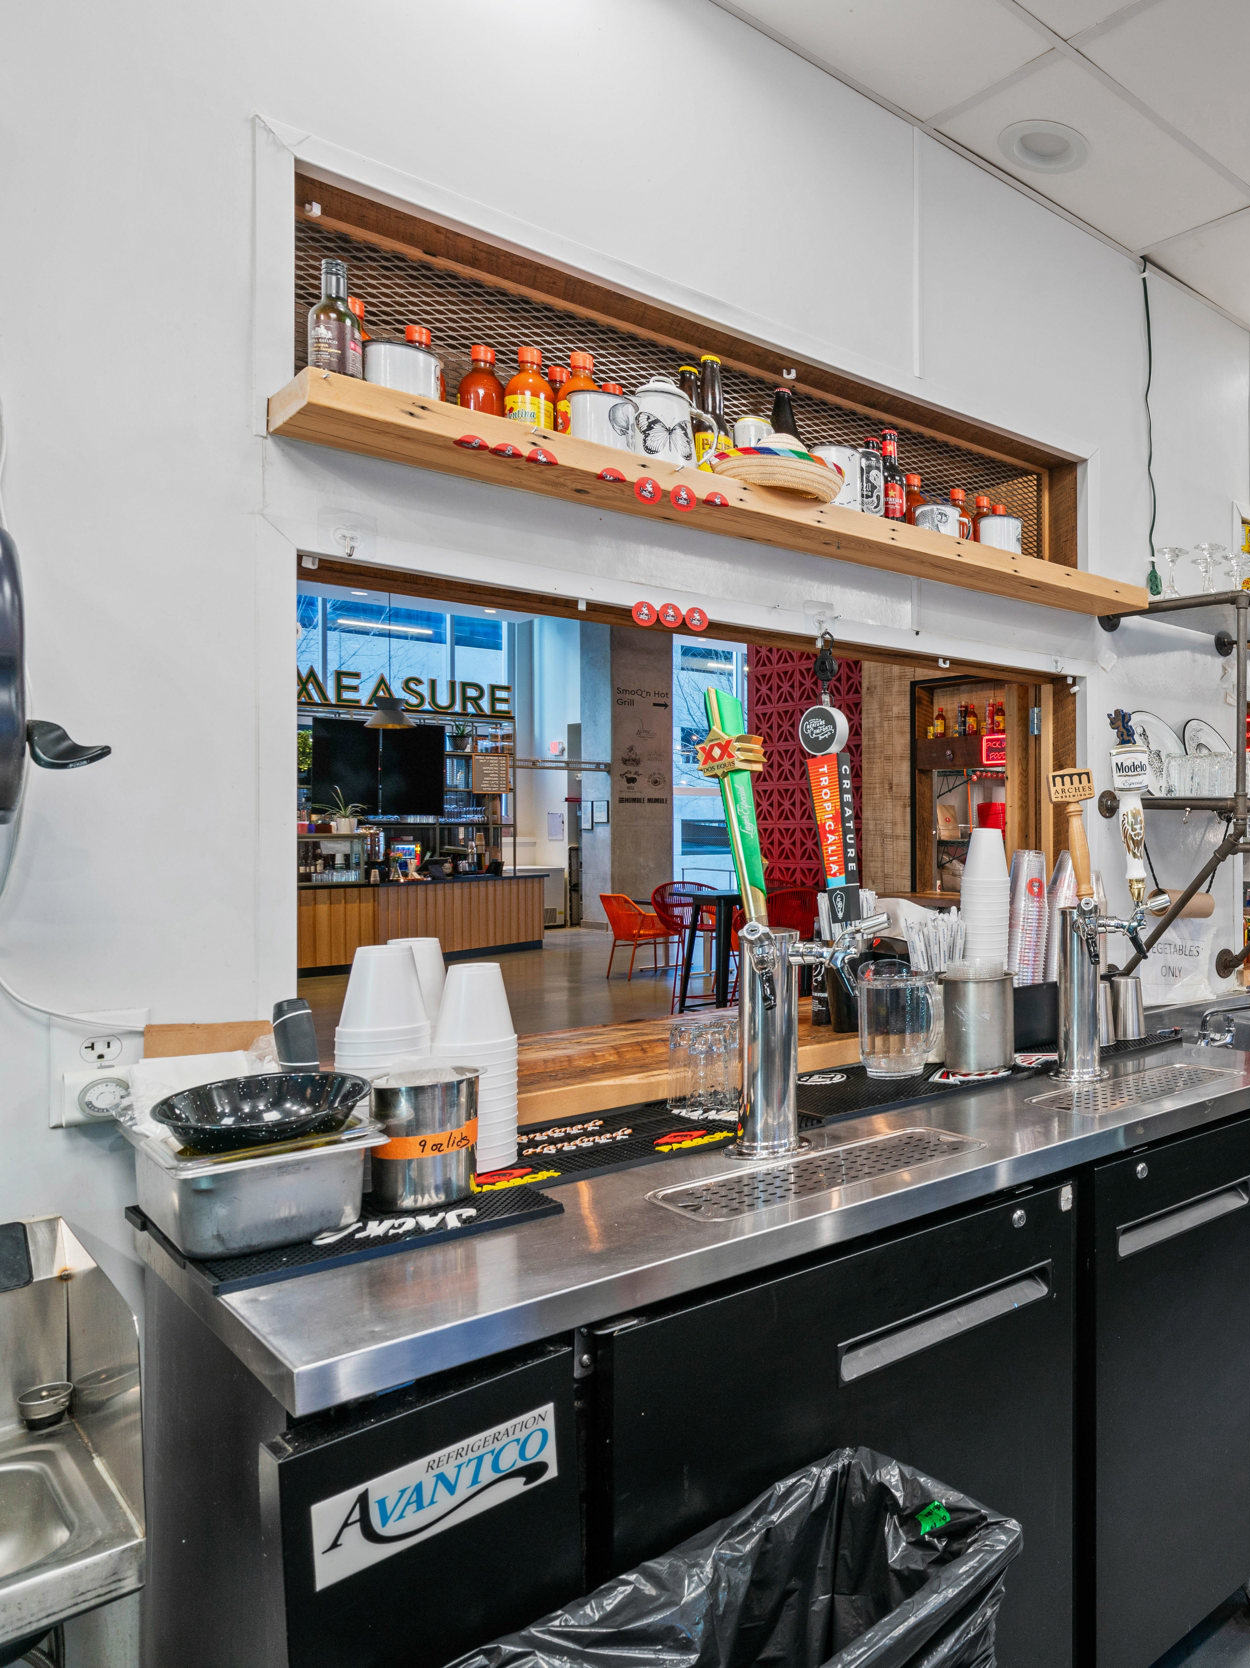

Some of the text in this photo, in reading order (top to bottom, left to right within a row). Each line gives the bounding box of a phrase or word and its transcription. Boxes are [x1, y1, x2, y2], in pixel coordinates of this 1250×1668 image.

[297, 665, 513, 716] MEASURE
[653, 690, 669, 699] Hot
[616, 698, 635, 707] Grill
[699, 738, 736, 766] XX
[703, 761, 736, 774] DOS EQUIS
[1115, 761, 1147, 775] Modelo
[1053, 785, 1093, 795] ARCHES
[841, 764, 857, 871] CREATURE
[1152, 943, 1200, 958] EGETABLES
[1160, 965, 1183, 978] ONLY
[418, 1139, 427, 1153] 9
[425, 1410, 549, 1473] REFRIGERATION
[321, 1427, 550, 1556] AVANTCO
